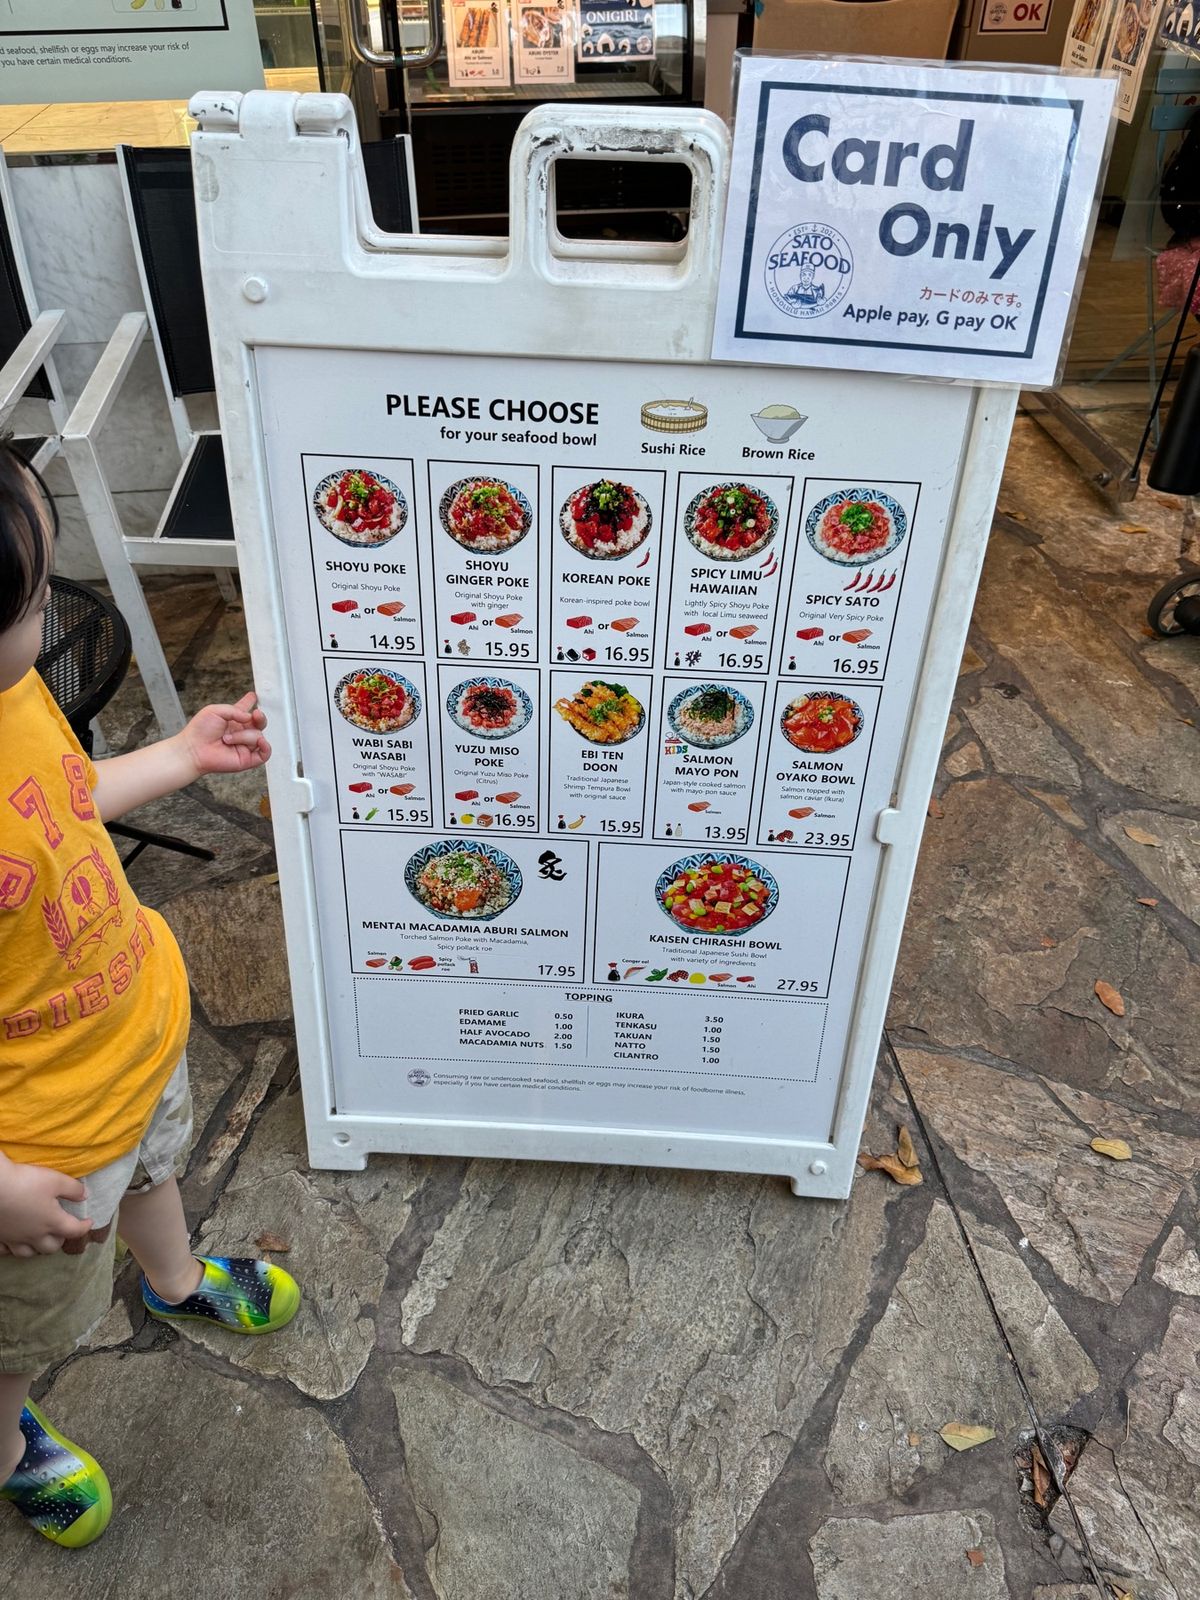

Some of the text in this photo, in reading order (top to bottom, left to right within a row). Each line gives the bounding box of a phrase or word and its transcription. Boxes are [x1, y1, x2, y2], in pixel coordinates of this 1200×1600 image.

[586, 9, 638, 23] ONIGIRI
[1013, 3, 1041, 21] OK
[6, 46, 38, 55] seafood,
[39, 45, 69, 54] shellfish
[80, 46, 99, 55] eggs
[100, 46, 116, 54] may
[117, 44, 147, 52] increase
[148, 44, 165, 53] your
[167, 42, 180, 50] risk
[181, 41, 189, 50] of
[0, 55, 132, 68] you have certain medical conditions.
[782, 114, 975, 192] Card
[792, 235, 833, 250] SATO
[879, 202, 1036, 280] Only
[768, 251, 850, 274] SEAFOOD
[919, 286, 1022, 308] カードのみです。
[842, 304, 1016, 332] Apple pay, G pay OK
[386, 394, 599, 425] PLEASE CHOOSE
[440, 426, 596, 446] for your seafood bowl
[641, 442, 706, 456] Sushi Rice
[742, 447, 815, 460] Brown Rice
[326, 561, 406, 574] SHOYU POKE
[466, 560, 508, 572] SHOYU
[563, 573, 650, 586] KOREAN POKE
[691, 568, 762, 580] SPICY LIMU
[331, 582, 359, 591] Original
[360, 584, 382, 592] Shoyu
[446, 574, 529, 588] GINGER POKE
[690, 583, 757, 595] HAWAIIAN
[455, 591, 481, 600] Original
[483, 593, 504, 601] Shoyu
[806, 595, 880, 607] SPICY SATO
[487, 602, 509, 610] ginger
[685, 600, 769, 611] Lightly Spicy Shoyu Poke
[799, 611, 827, 620] Original
[829, 613, 845, 621] Very
[846, 614, 865, 622] Spicy
[370, 634, 415, 650] 14.95
[485, 642, 529, 657] 15.95
[605, 646, 649, 662] 16.95
[719, 653, 763, 669] 16.95
[833, 658, 879, 674] 16.95
[352, 738, 412, 749] WABI SABI
[665, 745, 688, 755] KIDS
[360, 751, 406, 761] WASABI
[455, 745, 519, 756] YUZU MISO
[582, 750, 623, 760] EBI TEN
[475, 758, 504, 767] POKE
[683, 754, 733, 765] SALMON
[792, 761, 843, 771] SALMON
[583, 763, 617, 772] DOON
[675, 767, 738, 778] MAYO PON
[776, 772, 855, 785] OYAKO BOWL
[388, 809, 429, 822] 15.95
[495, 814, 535, 827] 16.95
[600, 820, 640, 833] 15.95
[705, 826, 745, 840] 13.95
[804, 832, 850, 846] 23.95
[362, 921, 568, 937] MENTAI MACADAMIA ABURI SALMON
[650, 935, 782, 950] KAISEN CHIRASHI BOWL
[538, 965, 575, 977] 17.95
[777, 979, 818, 992] 27.95
[565, 993, 612, 1002] TOPPING
[460, 1018, 506, 1026] EDAMAME
[615, 1022, 657, 1030] TENKASU
[485, 1030, 530, 1038] AVOCADO
[614, 1032, 652, 1040] TAKUAN
[460, 1038, 517, 1047] MACADAMIA
[614, 1052, 659, 1060] CILANTRO
